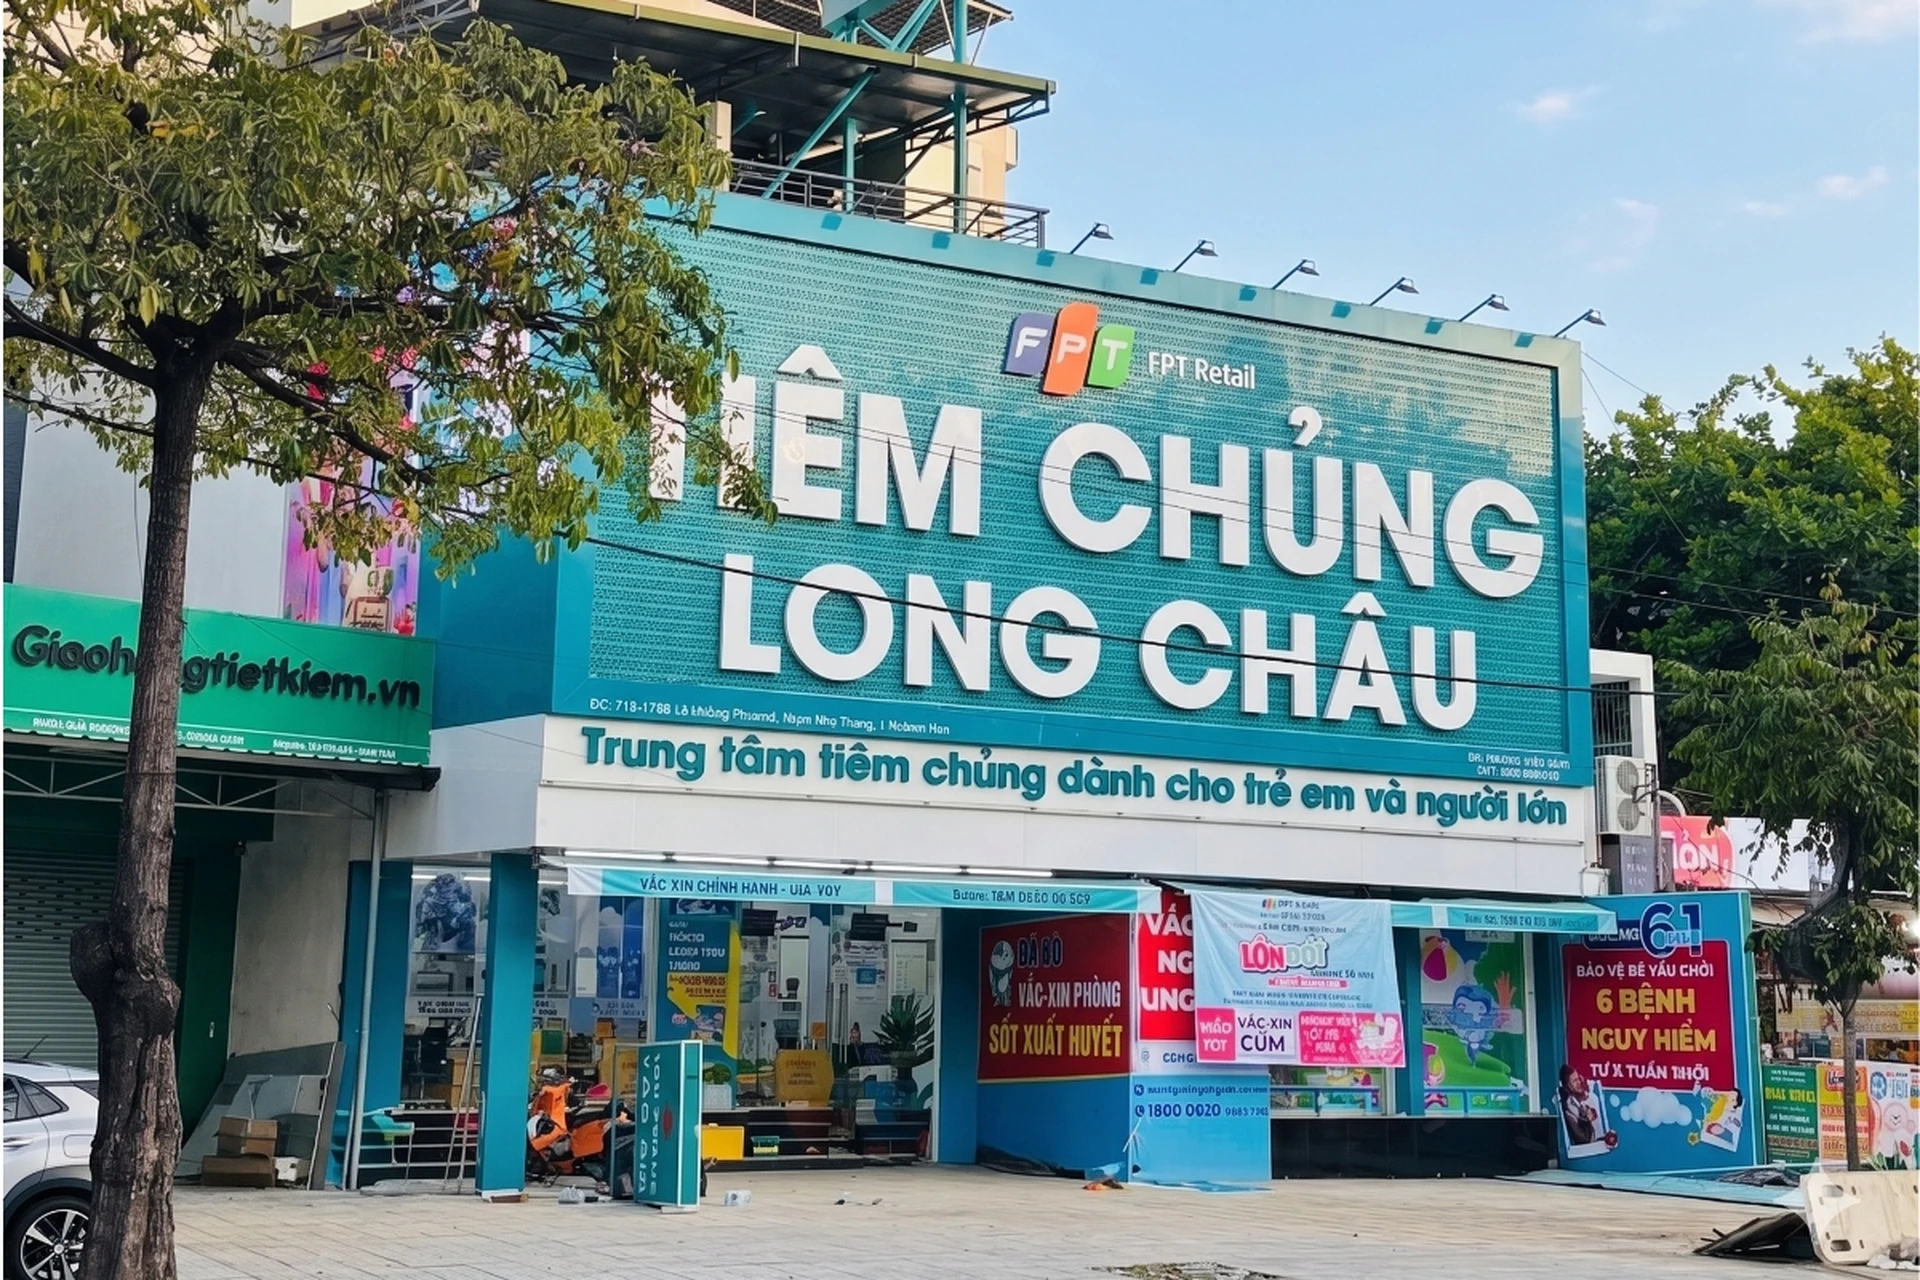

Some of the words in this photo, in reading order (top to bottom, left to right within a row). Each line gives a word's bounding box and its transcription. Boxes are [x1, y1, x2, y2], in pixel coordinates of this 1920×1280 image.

[1148, 351, 1190, 378] FPT
[1194, 356, 1256, 390] Retail
[1039, 406, 1545, 598] CHỦNG
[719, 553, 1102, 699] LONG
[1140, 592, 1478, 731] CHÂU
[12, 625, 421, 708] Giaohgtietkiem.vn
[581, 726, 706, 782] Trung
[719, 734, 806, 776] tâm
[818, 742, 910, 783] tiêm
[921, 746, 1048, 801] chủng
[1057, 756, 1155, 799] dành
[1165, 766, 1235, 803] cho
[1245, 768, 1289, 807] trẻ
[1301, 783, 1355, 811] em
[1365, 778, 1408, 815] và
[1417, 784, 1510, 828] người
[1517, 789, 1568, 825] lớn
[670, 879, 694, 892] XIN
[1073, 975, 1122, 1008] PHÒNG
[1596, 988, 1614, 1014] 6
[1619, 981, 1696, 1021] BỆNH
[989, 1013, 1019, 1055] SỐT
[1023, 1013, 1065, 1056] XUẤT
[1069, 1013, 1123, 1058] HUYẾT
[1582, 1028, 1648, 1051] NGUY
[1653, 1018, 1717, 1052] HIỂM
[1147, 1103, 1182, 1118] 1800
[1185, 1103, 1222, 1118] 0020
